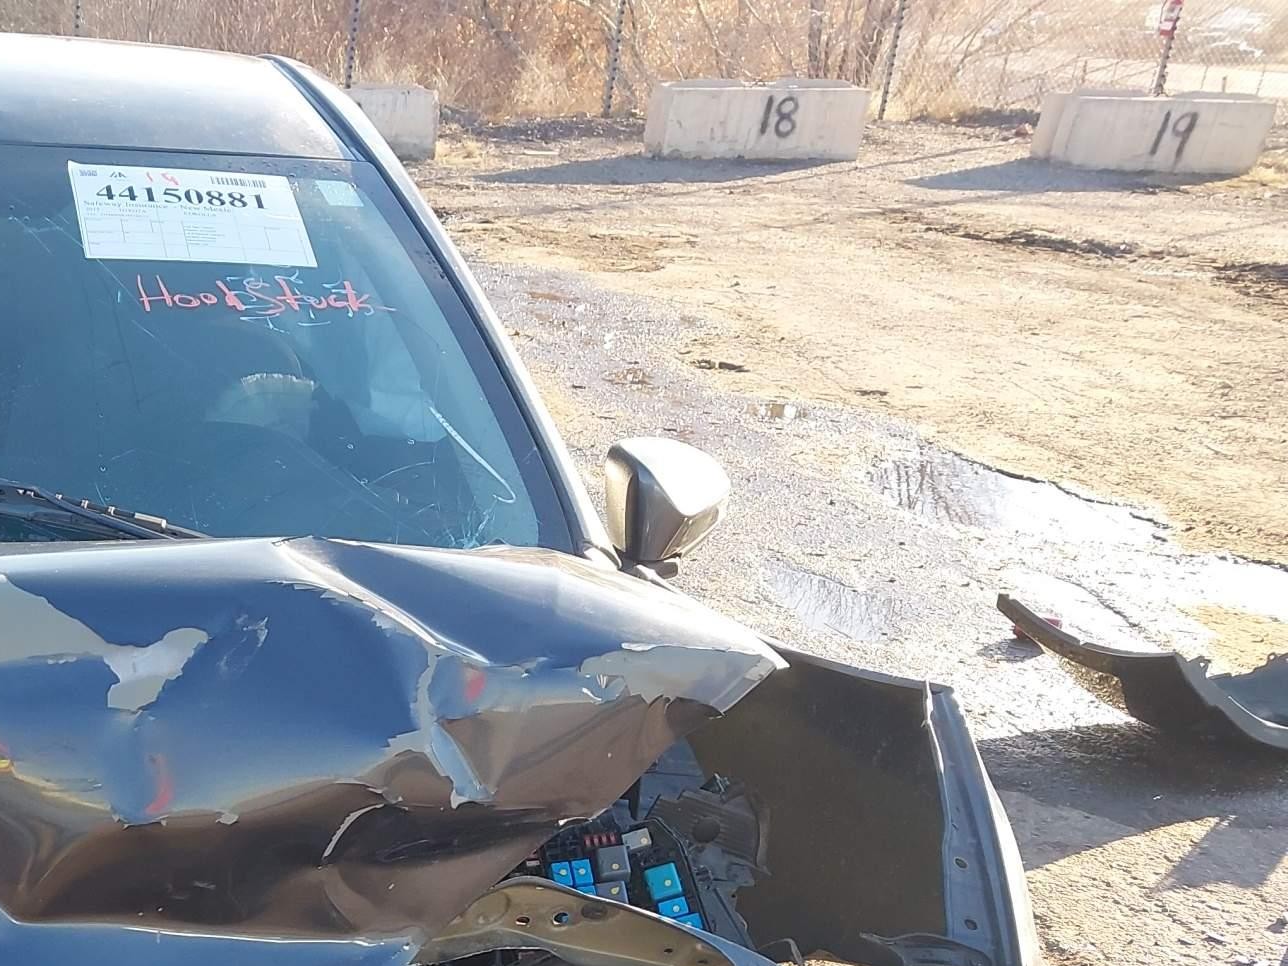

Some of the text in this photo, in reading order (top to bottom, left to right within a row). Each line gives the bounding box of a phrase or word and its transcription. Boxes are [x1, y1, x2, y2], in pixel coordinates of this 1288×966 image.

[760, 95, 799, 138] 18
[1149, 110, 1199, 167] 19
[96, 184, 269, 210] 44150881
